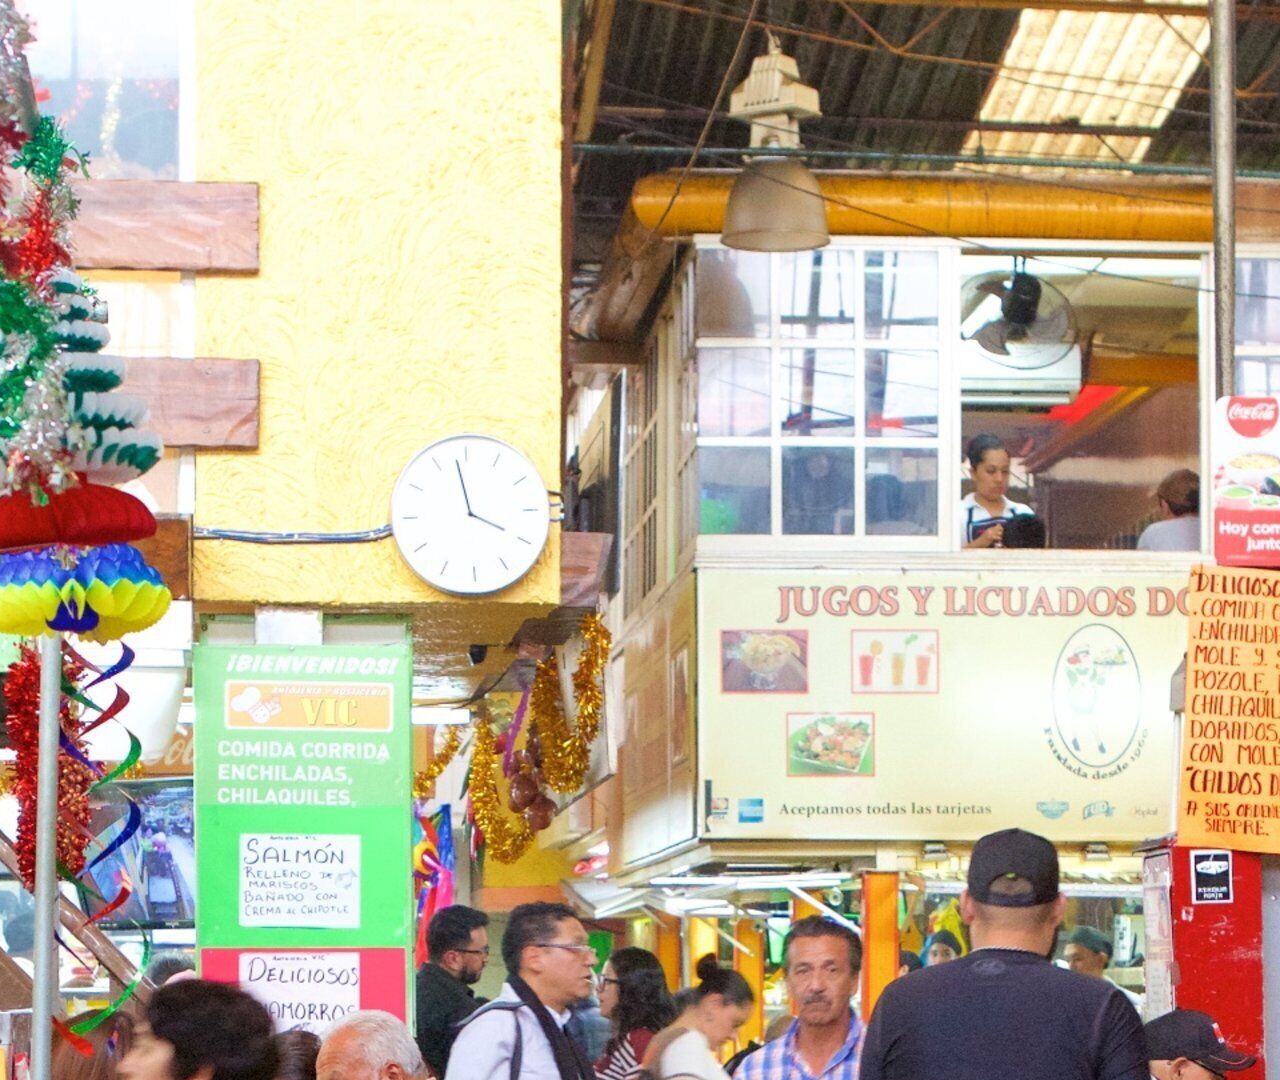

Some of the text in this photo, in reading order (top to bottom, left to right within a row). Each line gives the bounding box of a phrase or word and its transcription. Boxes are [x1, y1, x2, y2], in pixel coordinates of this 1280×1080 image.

[1219, 520, 1250, 536] Hoy
[777, 585, 1137, 622] JUGOS Y LICUADOS
[226, 654, 399, 676] ¡BIENVENIDOS!
[1194, 645, 1239, 667] MOLE
[300, 697, 358, 726] VIC
[217, 740, 297, 759] COMIDA
[1189, 741, 1224, 764] CON
[218, 763, 353, 785] ENCHILADAS,
[1092, 762, 1129, 780] desde
[779, 802, 861, 819] Aceptamos
[867, 803, 904, 815] todas
[910, 803, 933, 815] las
[937, 803, 993, 818] tarjetas
[1204, 802, 1231, 819] SUS
[243, 838, 345, 865] SALMÓN
[245, 866, 311, 881] RELLENO
[248, 880, 319, 892] MARISCOS
[244, 904, 282, 918] CREMA
[248, 957, 360, 987] DELICIOSOS
